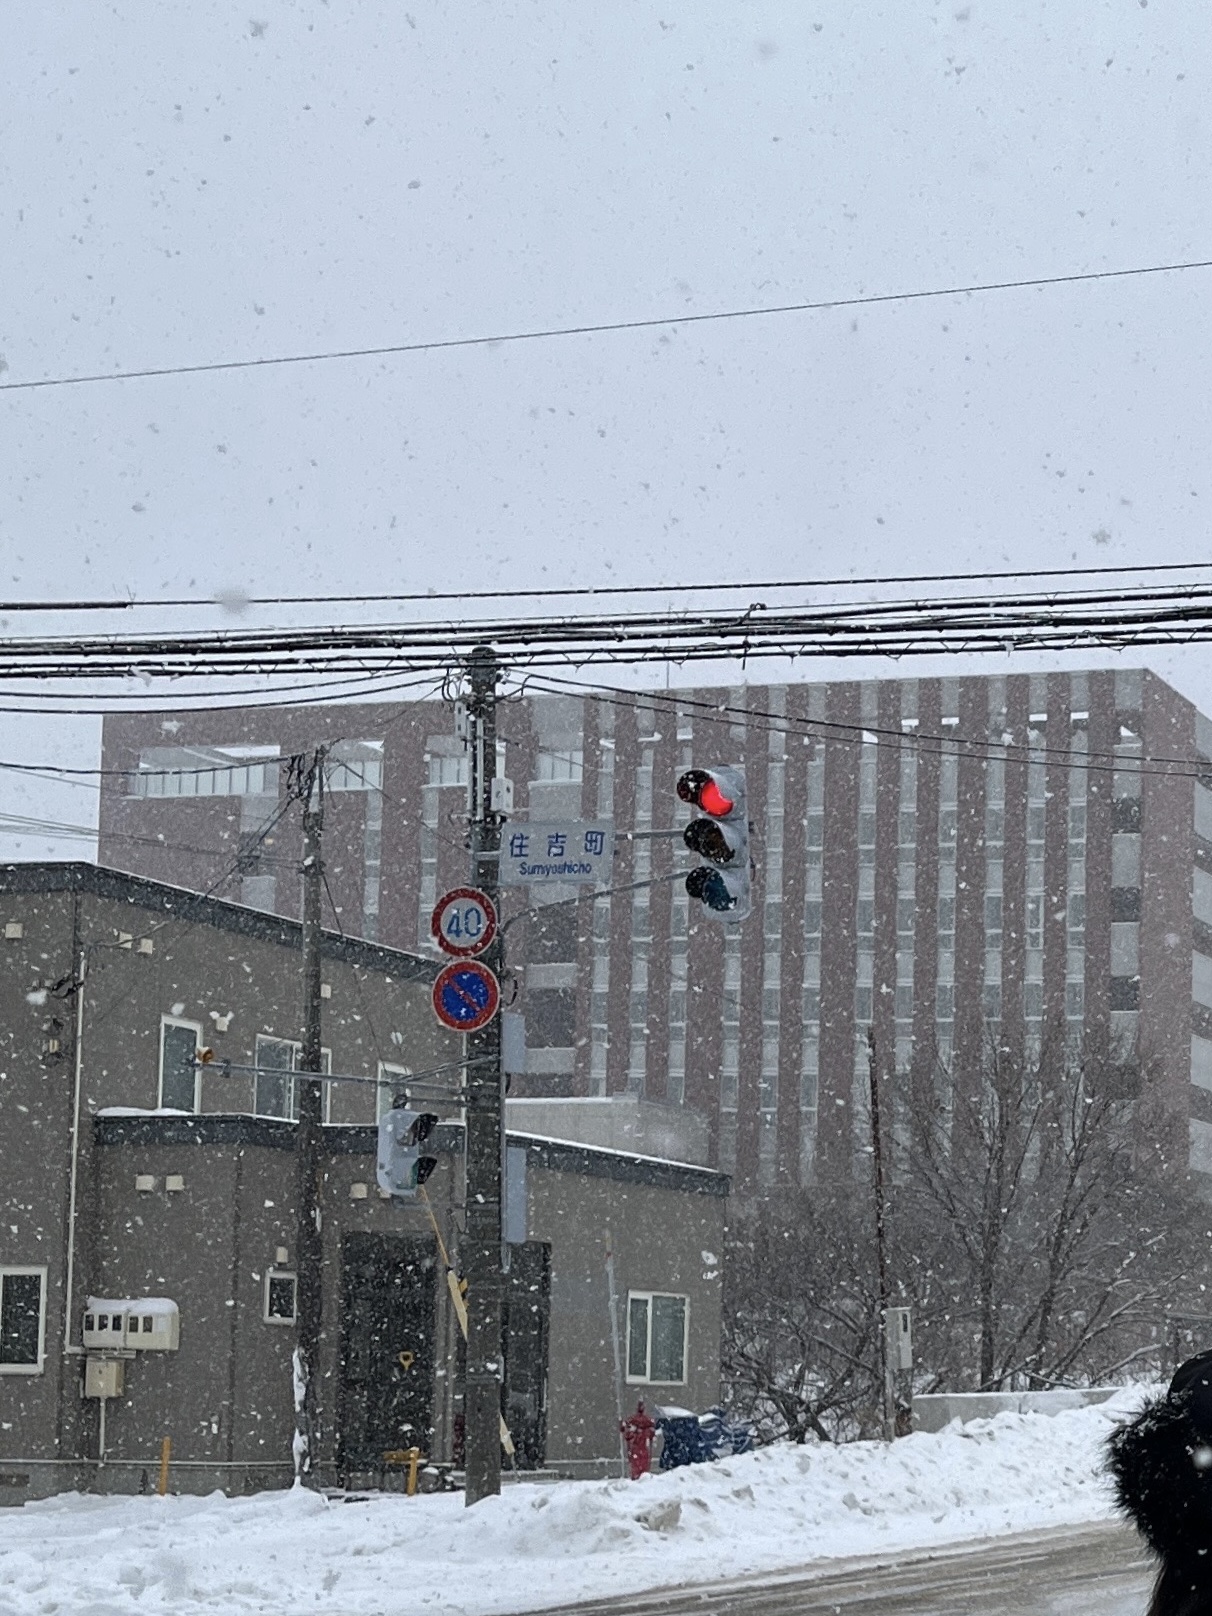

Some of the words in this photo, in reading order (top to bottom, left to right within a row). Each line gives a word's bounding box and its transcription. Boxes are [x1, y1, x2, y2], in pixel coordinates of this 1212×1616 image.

[510, 831, 605, 857] 住吉町
[447, 907, 481, 937] 40
